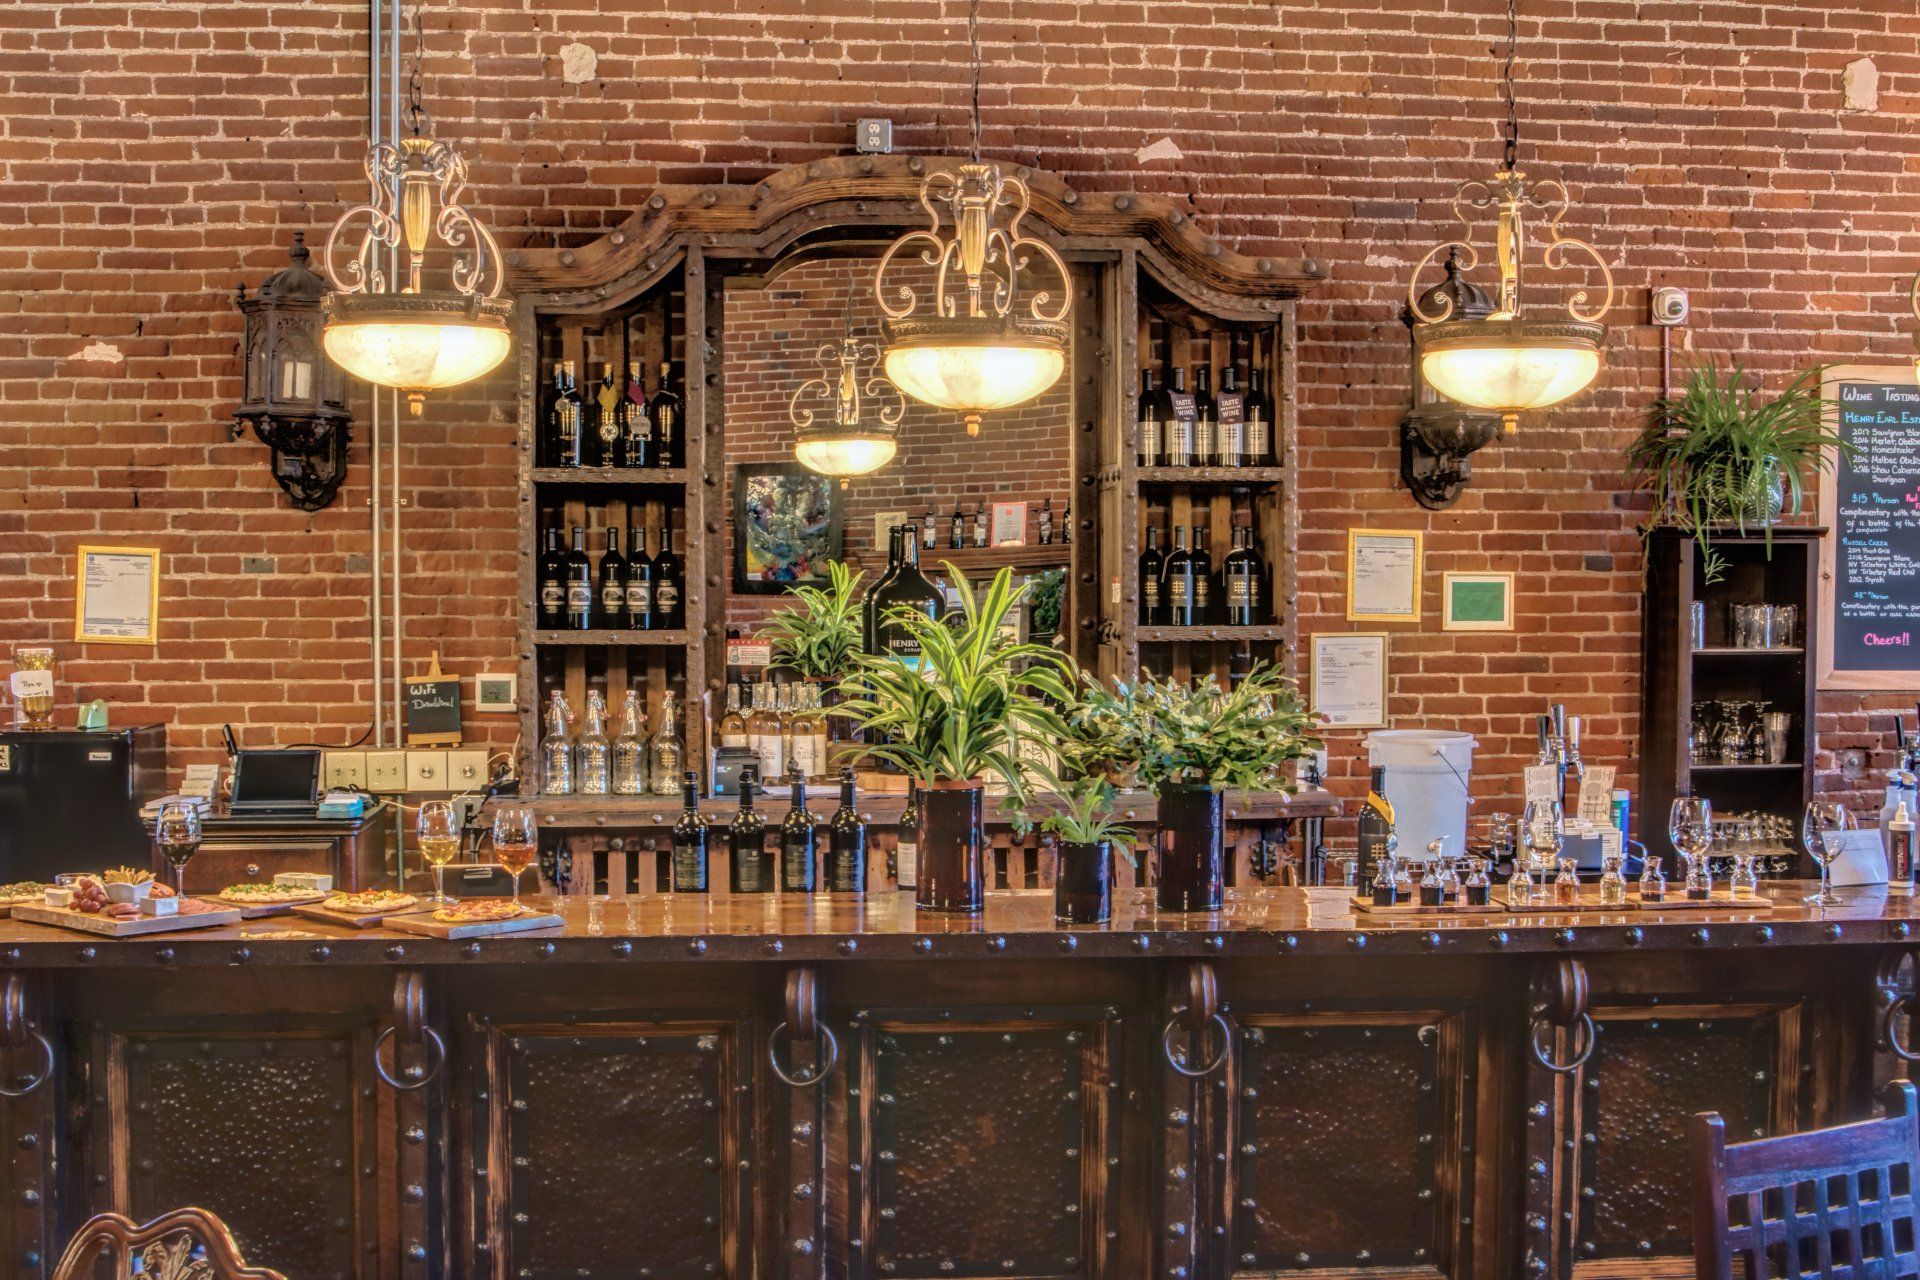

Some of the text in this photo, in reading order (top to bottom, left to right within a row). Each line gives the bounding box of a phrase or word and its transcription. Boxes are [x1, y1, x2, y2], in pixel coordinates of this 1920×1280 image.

[1221, 409, 1240, 418] WINE
[1845, 411, 1875, 423] HENRY
[1871, 428, 1905, 438] Sauvignon
[1871, 474, 1906, 486] Sauvignon
[1851, 492, 1868, 504] $15
[1839, 507, 1891, 519] Complimentary
[1893, 509, 1909, 517] with
[1846, 520, 1855, 528] of
[1867, 519, 1891, 527] bottle
[1895, 520, 1902, 529] of
